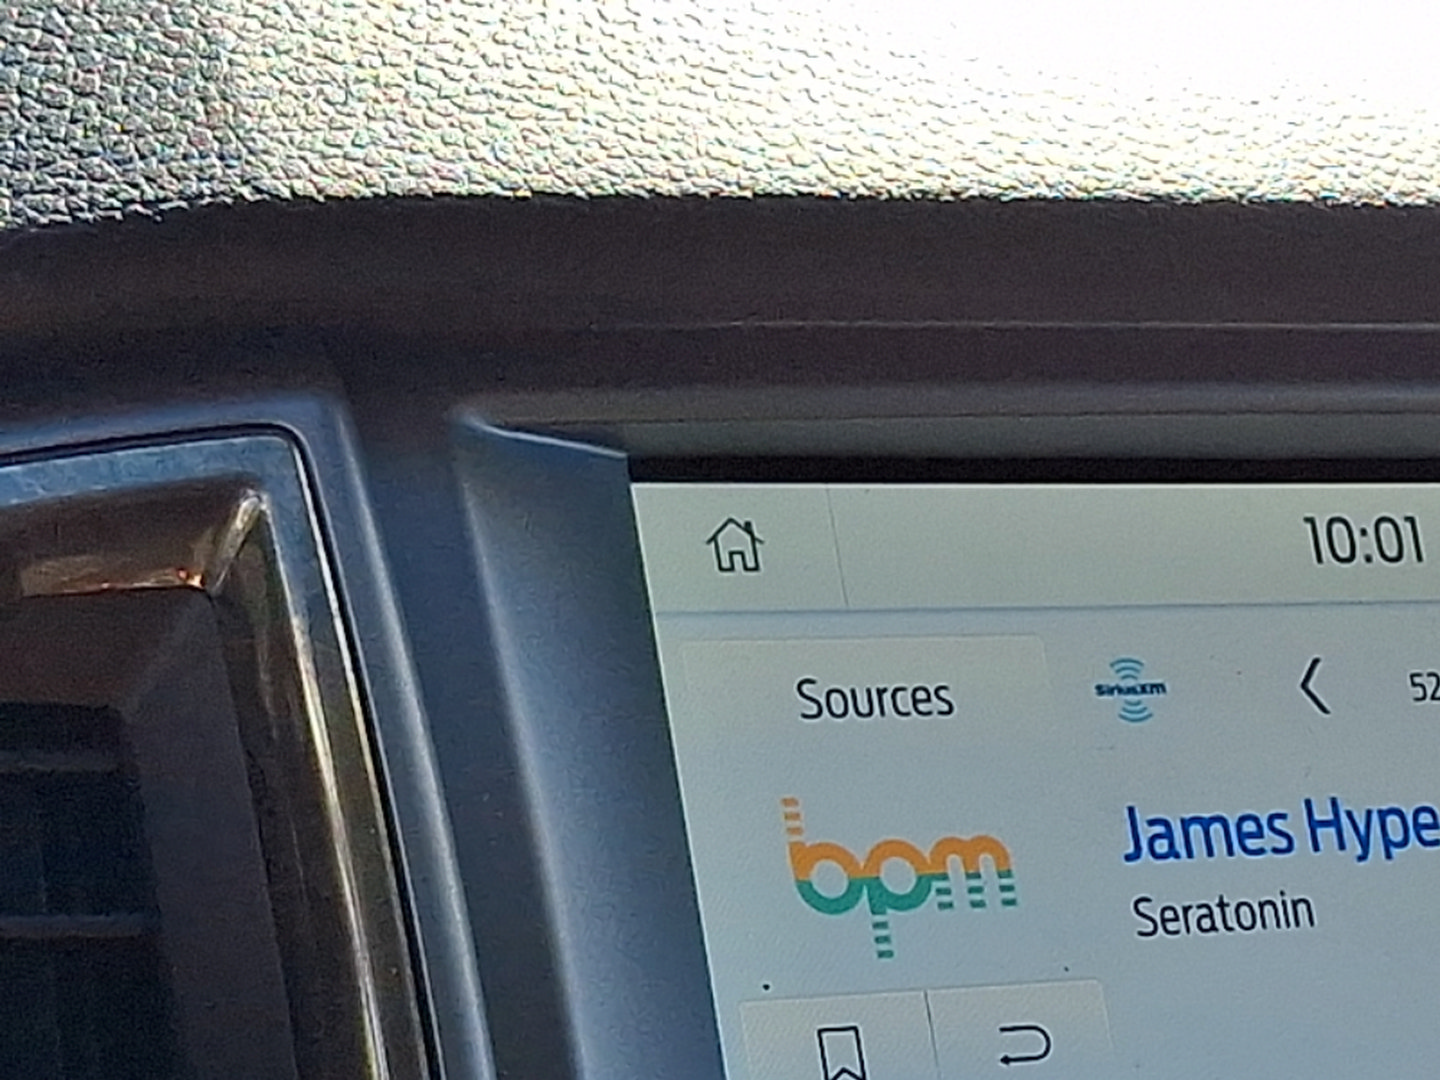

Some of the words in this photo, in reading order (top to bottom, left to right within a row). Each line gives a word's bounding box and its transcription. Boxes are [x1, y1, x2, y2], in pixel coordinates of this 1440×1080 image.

[1303, 515, 1423, 564] 10:01
[796, 678, 955, 720] Sources
[1122, 806, 1294, 865] James
[780, 797, 1017, 959] bpm
[1132, 891, 1315, 938] Seratonin
